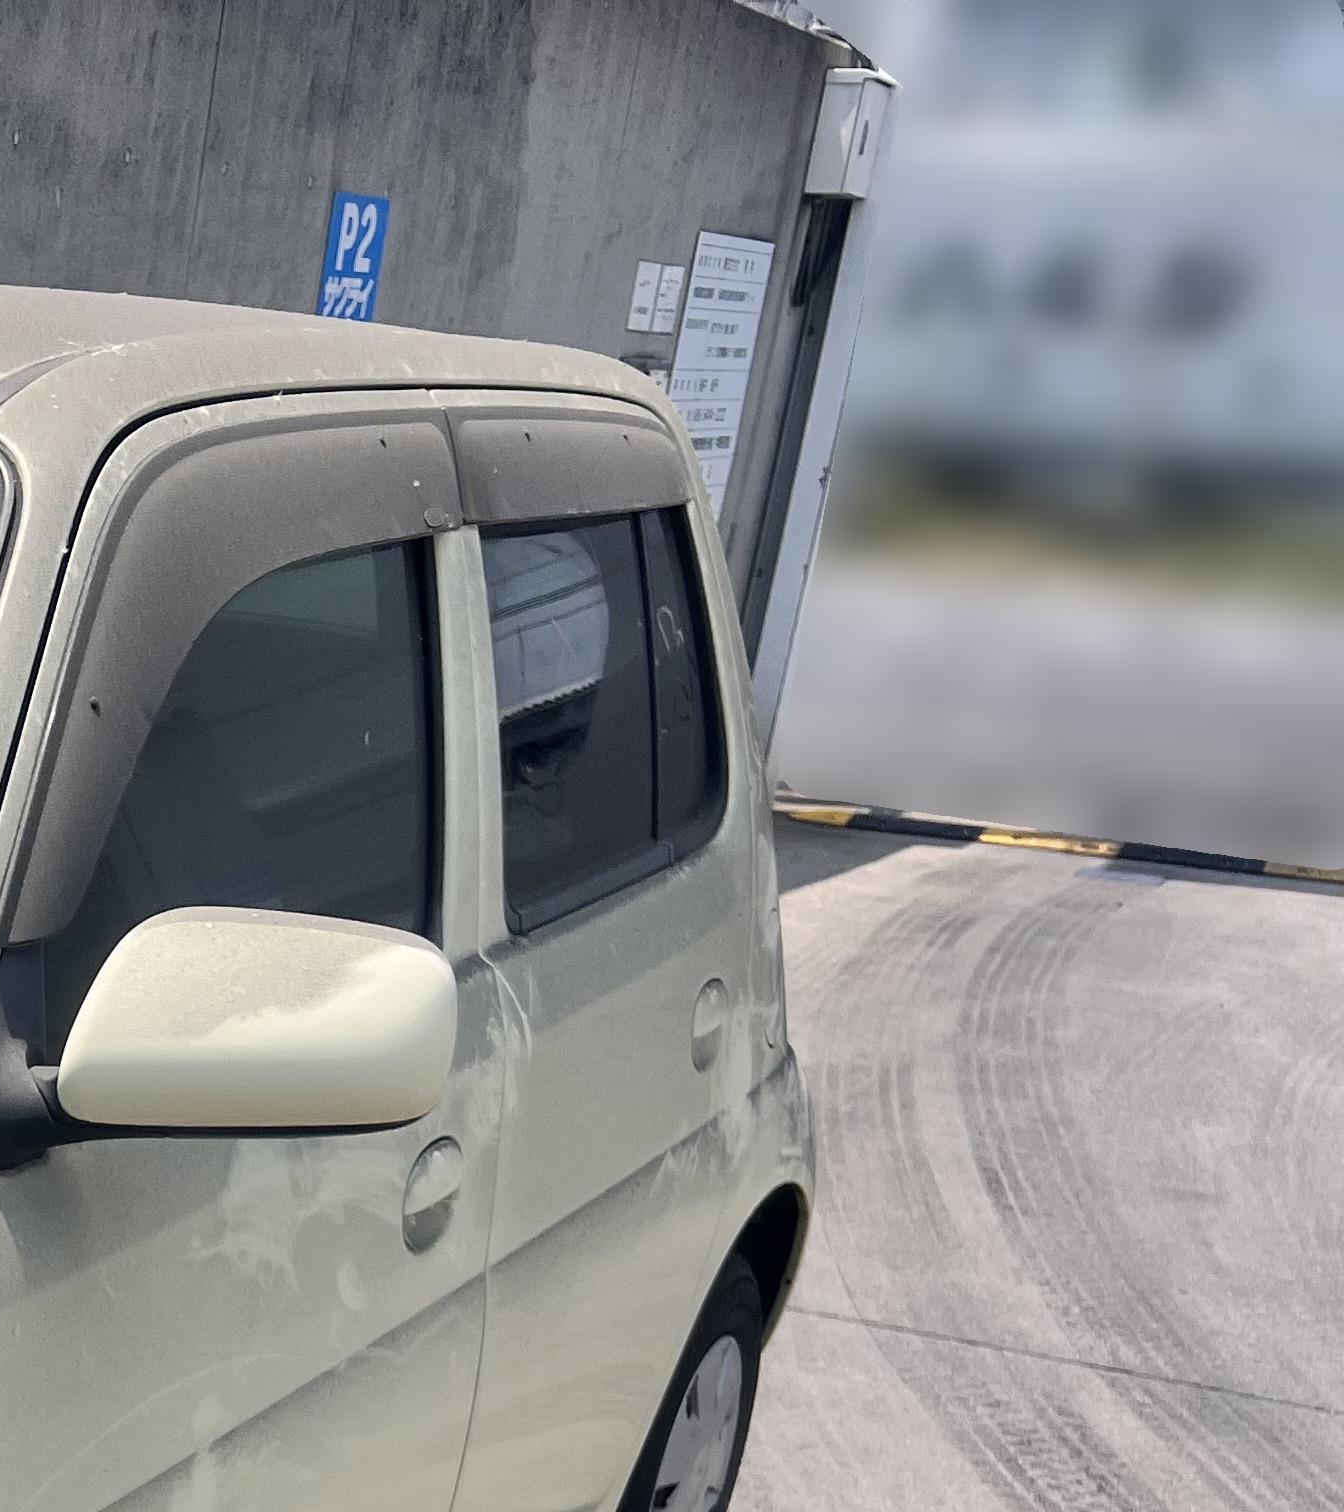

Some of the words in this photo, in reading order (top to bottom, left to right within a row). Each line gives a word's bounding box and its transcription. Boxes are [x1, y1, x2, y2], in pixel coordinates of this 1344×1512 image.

[335, 201, 378, 274] P2
[322, 276, 375, 320] サクライ
